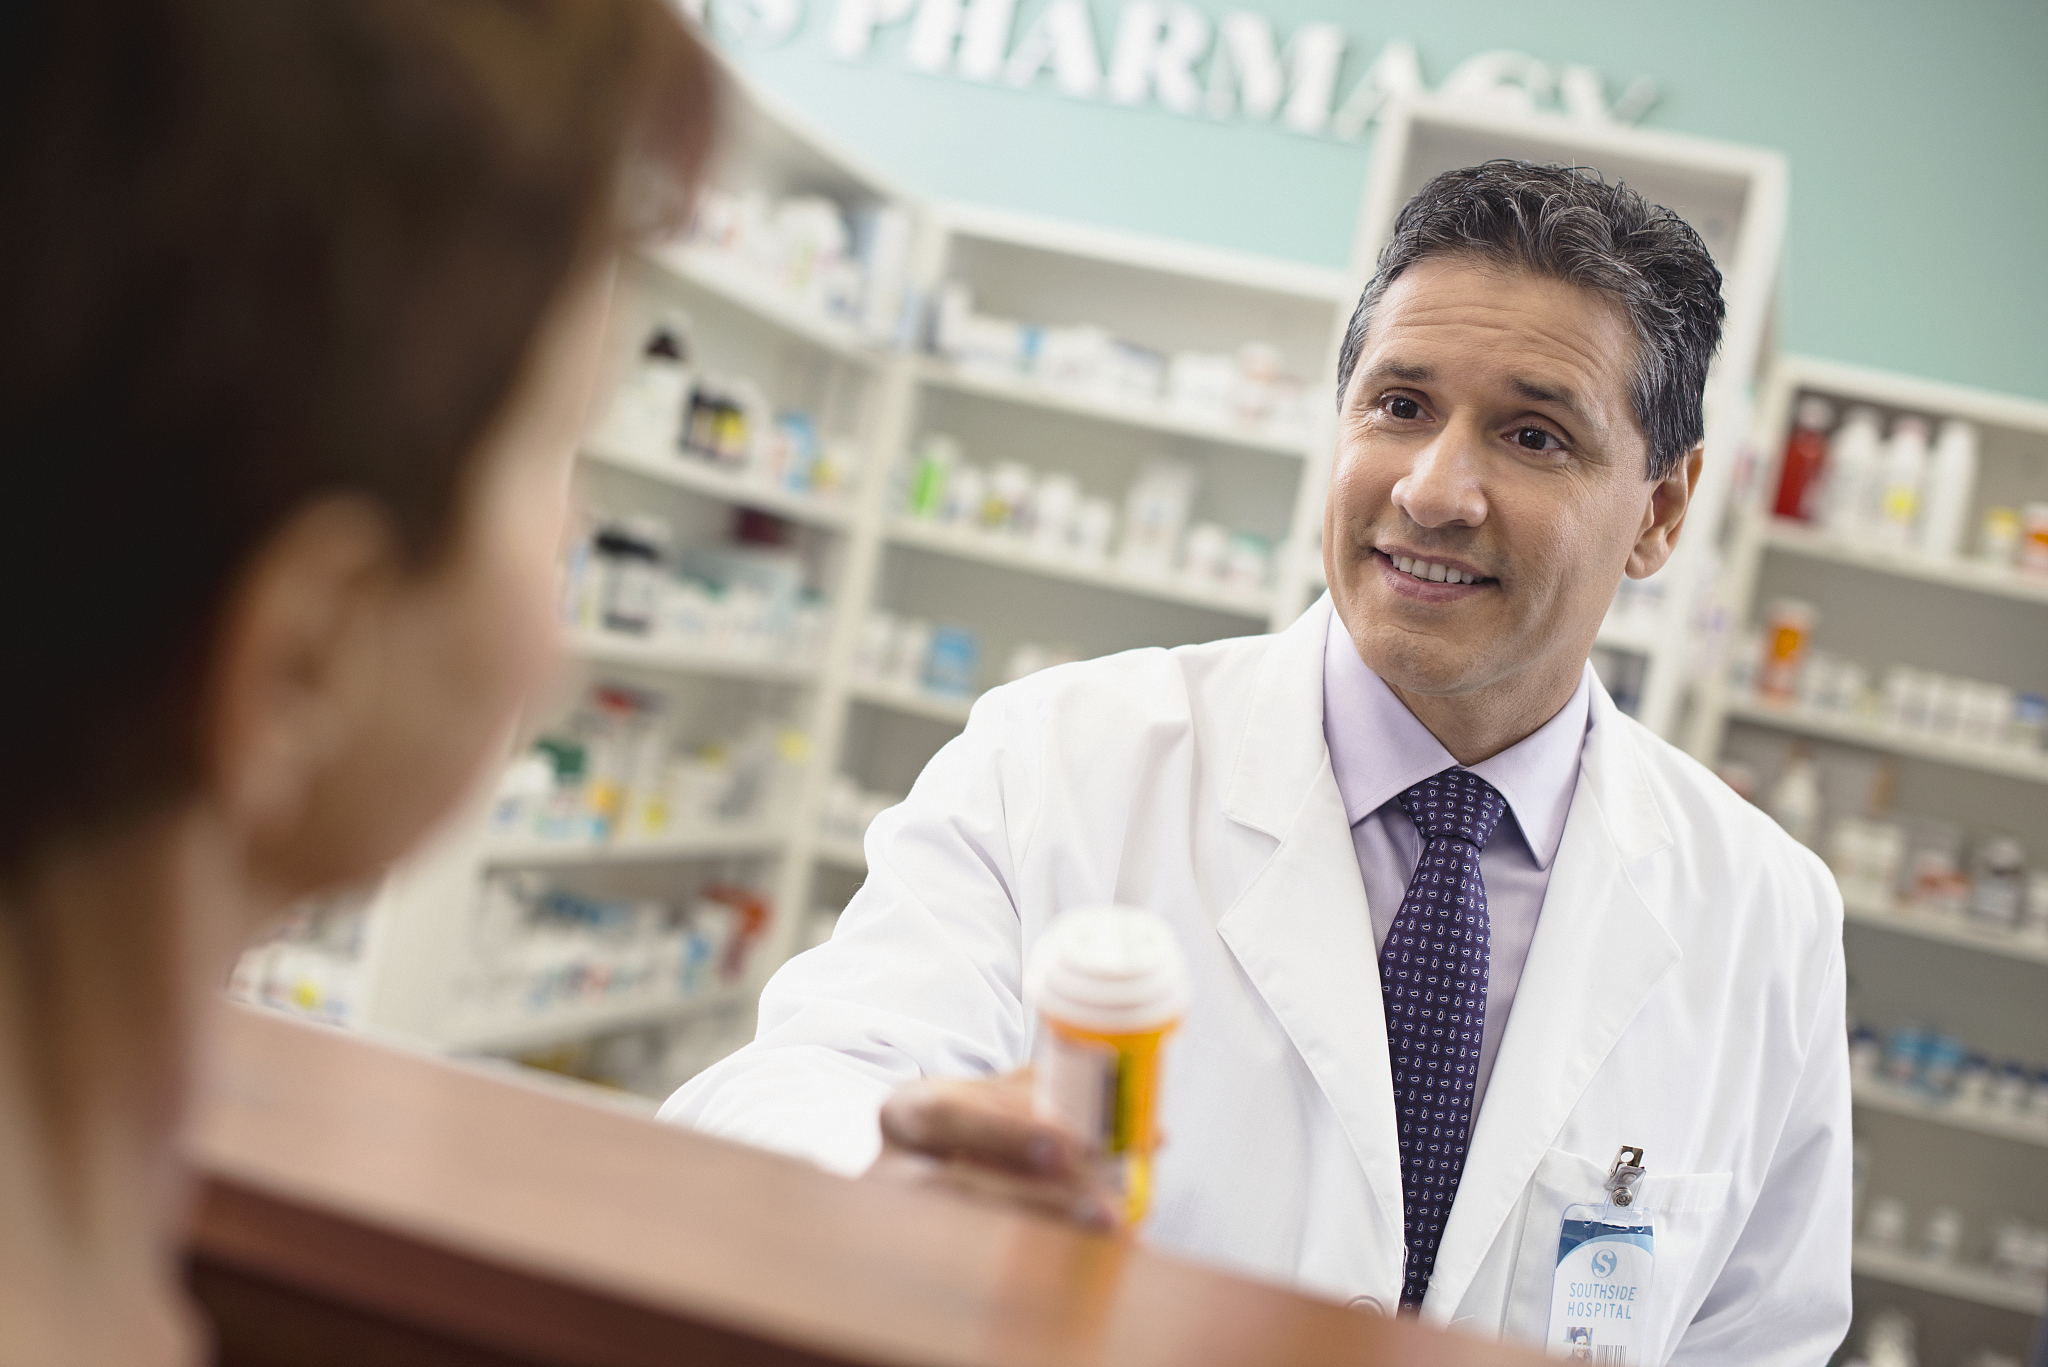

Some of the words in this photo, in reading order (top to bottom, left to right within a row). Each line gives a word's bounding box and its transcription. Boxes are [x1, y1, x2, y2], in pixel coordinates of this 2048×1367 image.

[1592, 1250, 1615, 1278] S
[1569, 1282, 1637, 1301] SOUTHSIDE
[1567, 1301, 1632, 1320] HOSPITAL
